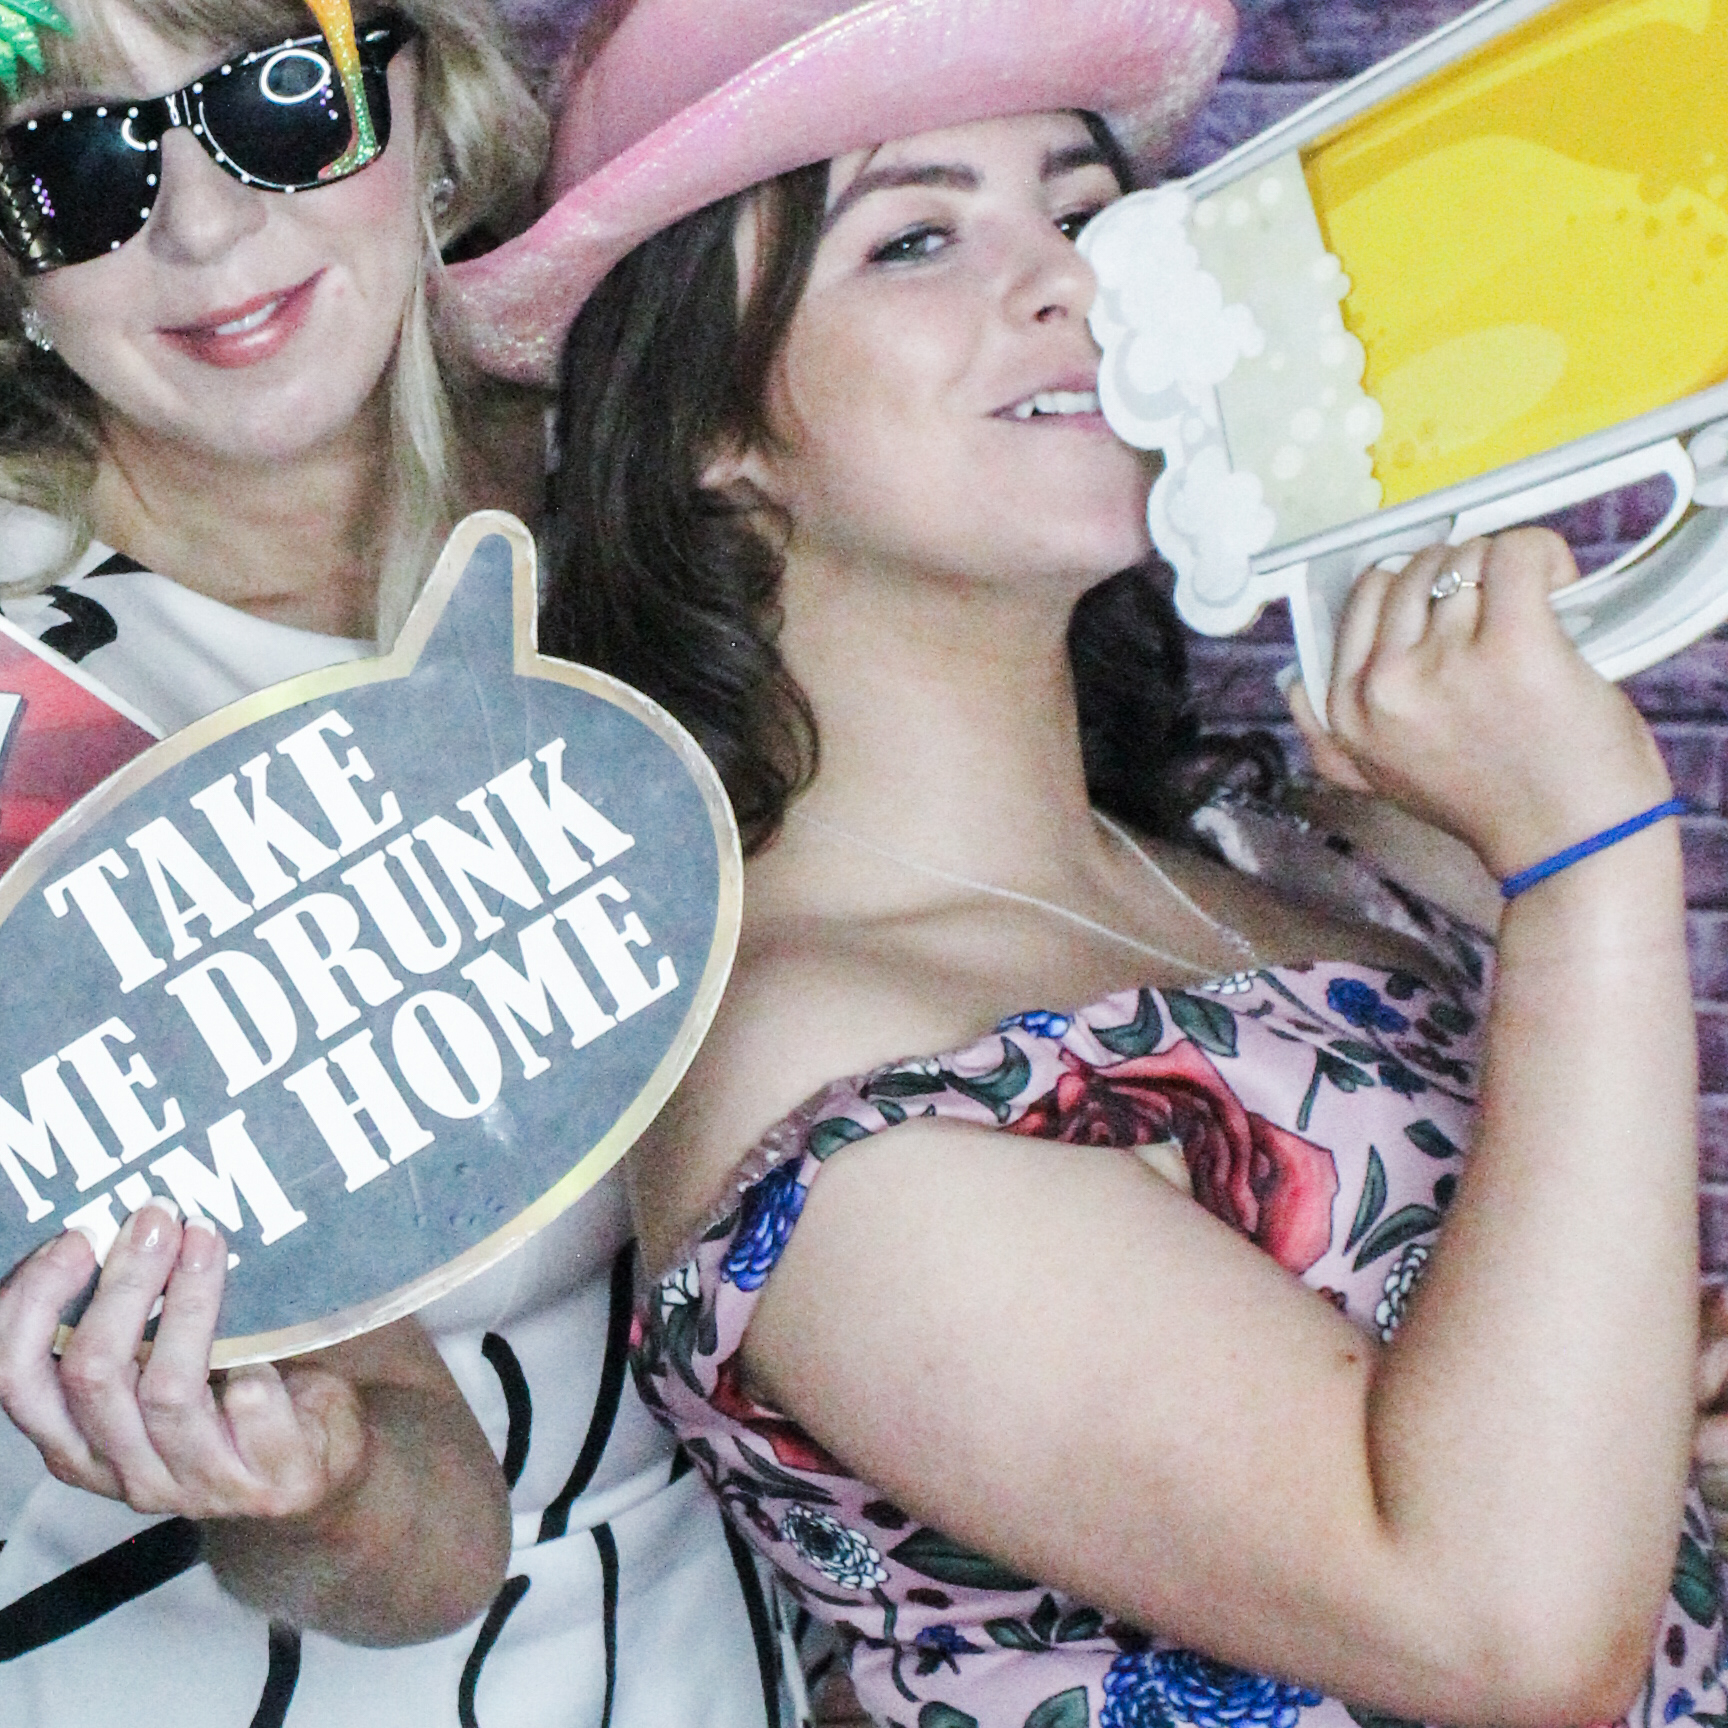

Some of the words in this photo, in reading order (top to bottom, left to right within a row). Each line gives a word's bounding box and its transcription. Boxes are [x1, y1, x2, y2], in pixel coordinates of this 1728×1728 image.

[43, 709, 403, 994] TAKE
[164, 736, 635, 1098] DRUNK
[283, 874, 680, 1194] HOME
